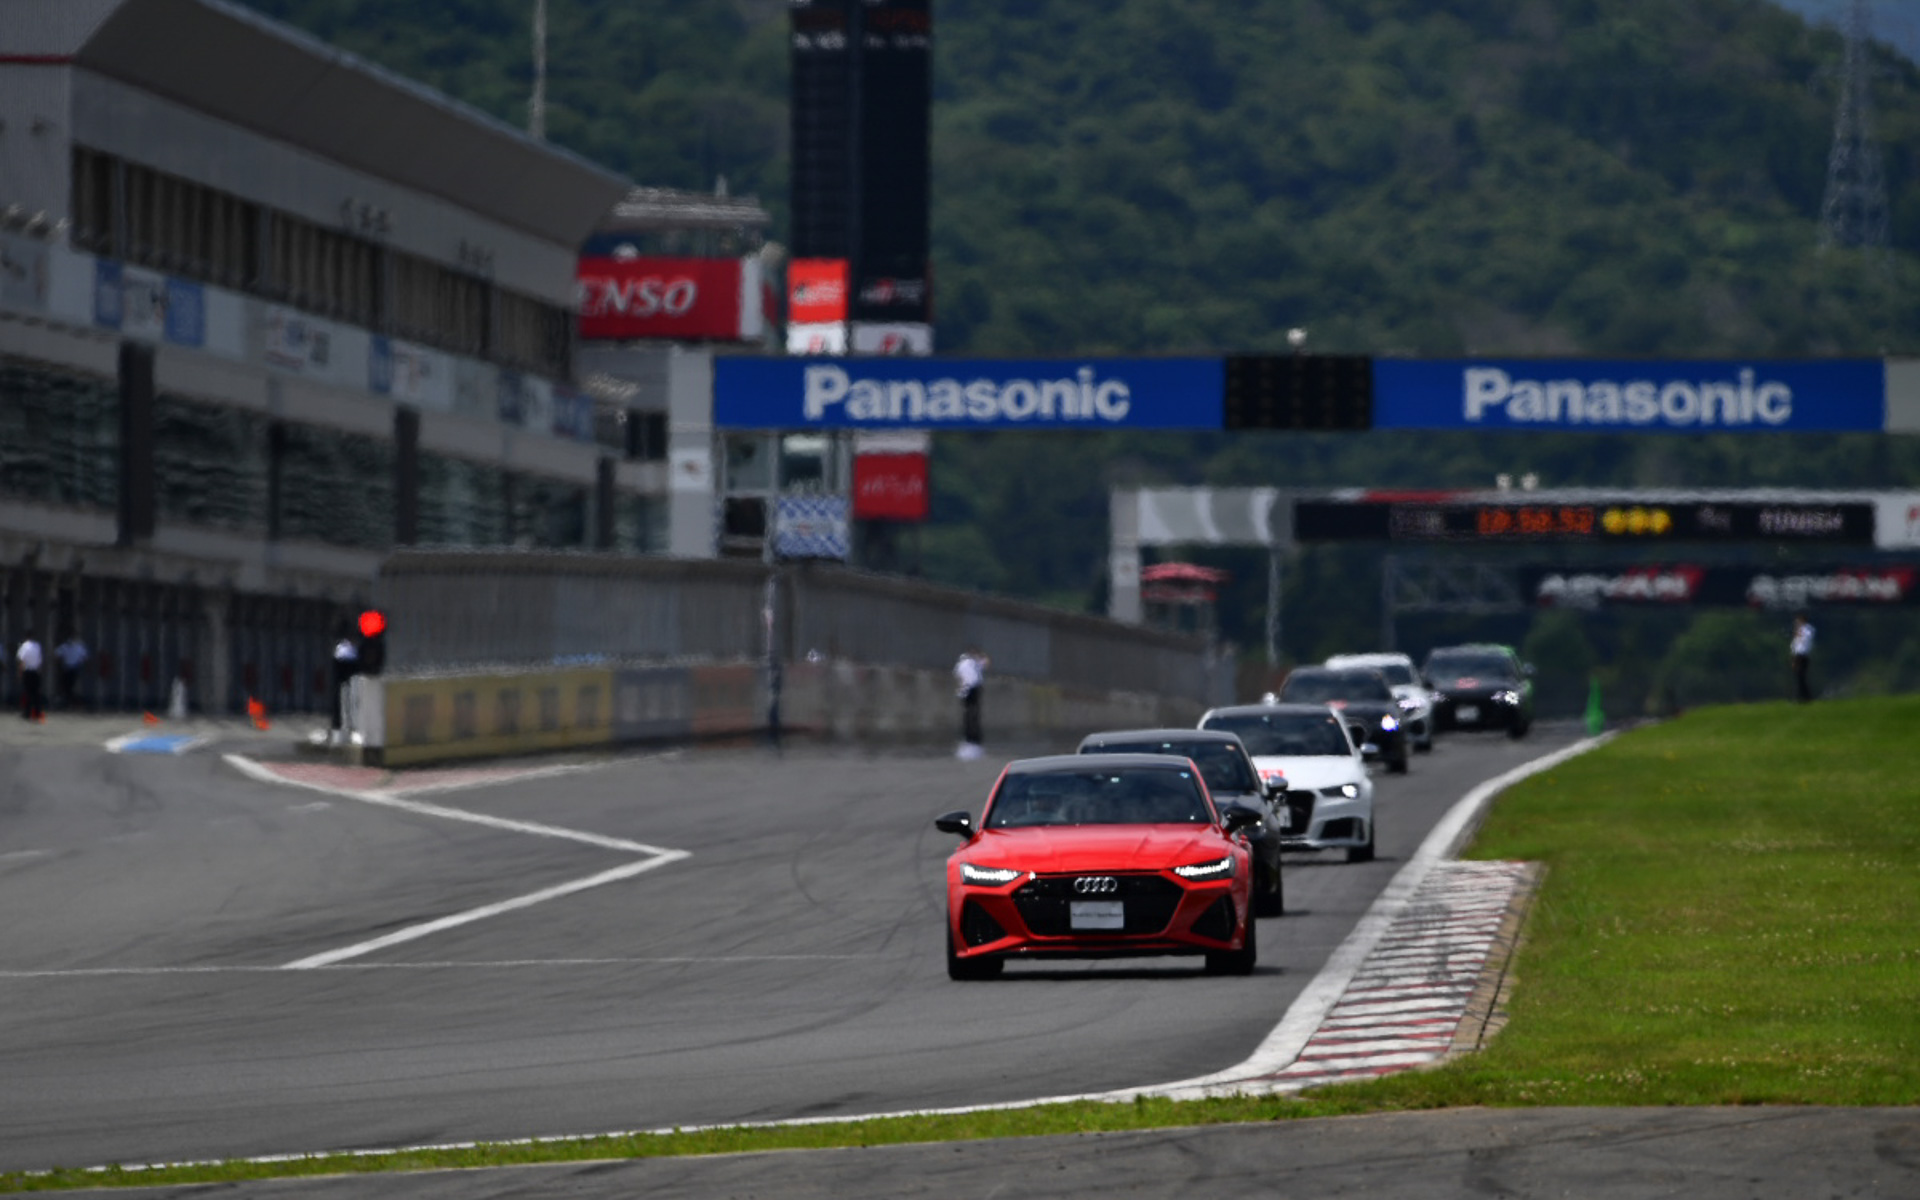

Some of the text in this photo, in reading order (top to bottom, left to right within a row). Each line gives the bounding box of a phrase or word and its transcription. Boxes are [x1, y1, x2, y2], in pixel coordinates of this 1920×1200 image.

[576, 276, 696, 317] ENSO
[803, 364, 1130, 421] Panasonic
[1463, 367, 1792, 424] Panasonic
